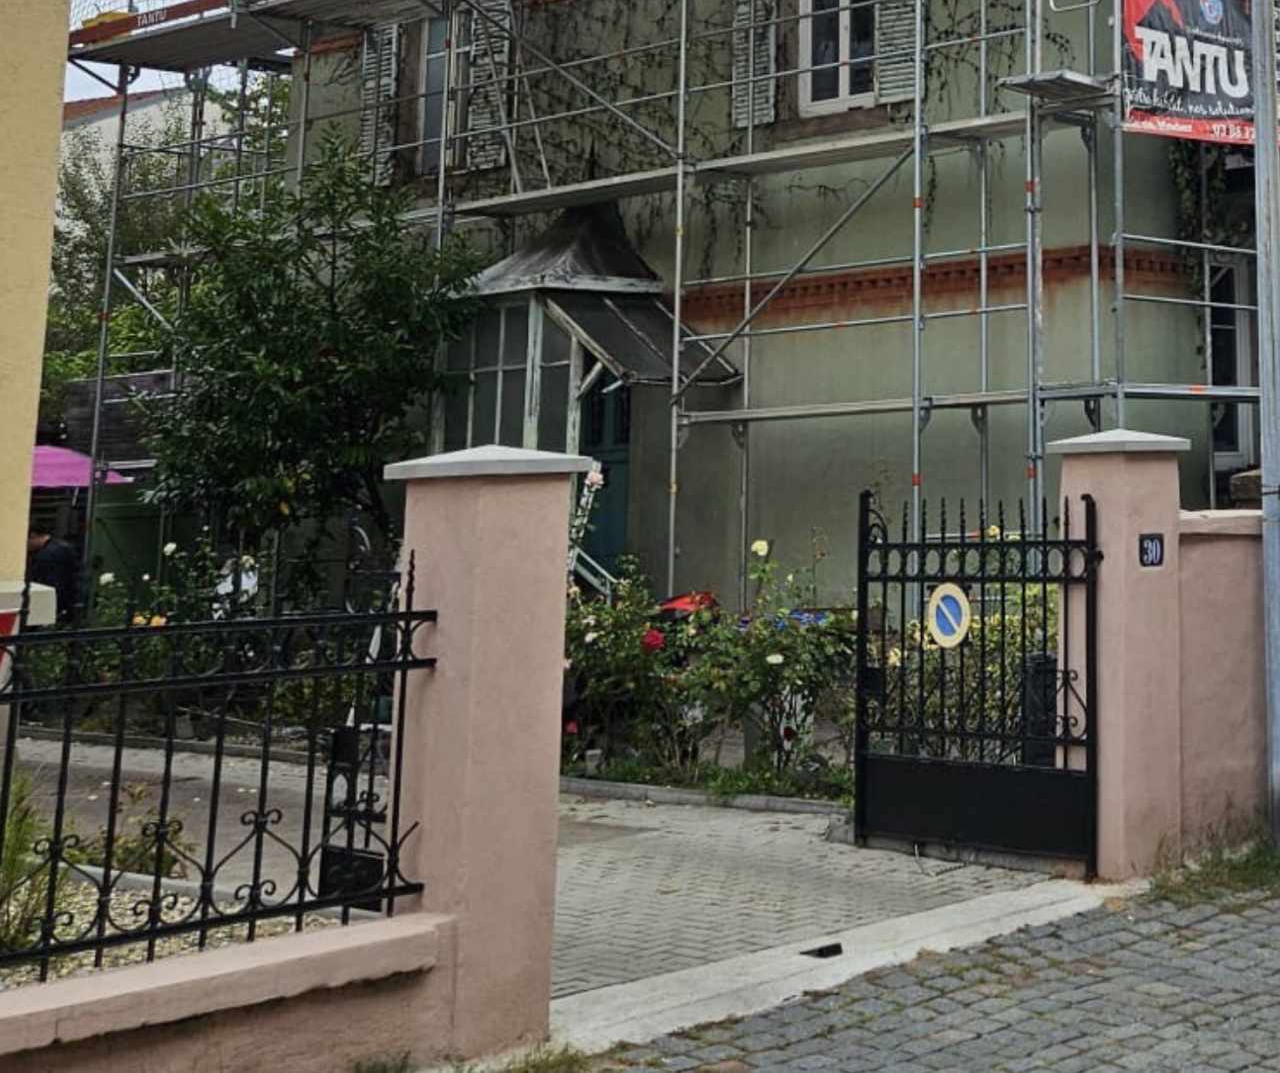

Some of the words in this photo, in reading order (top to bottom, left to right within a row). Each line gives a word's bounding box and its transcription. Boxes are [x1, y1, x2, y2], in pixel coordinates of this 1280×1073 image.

[137, 9, 166, 27] TANTU
[1134, 26, 1250, 98] TANTU
[1143, 539, 1161, 565] 30
